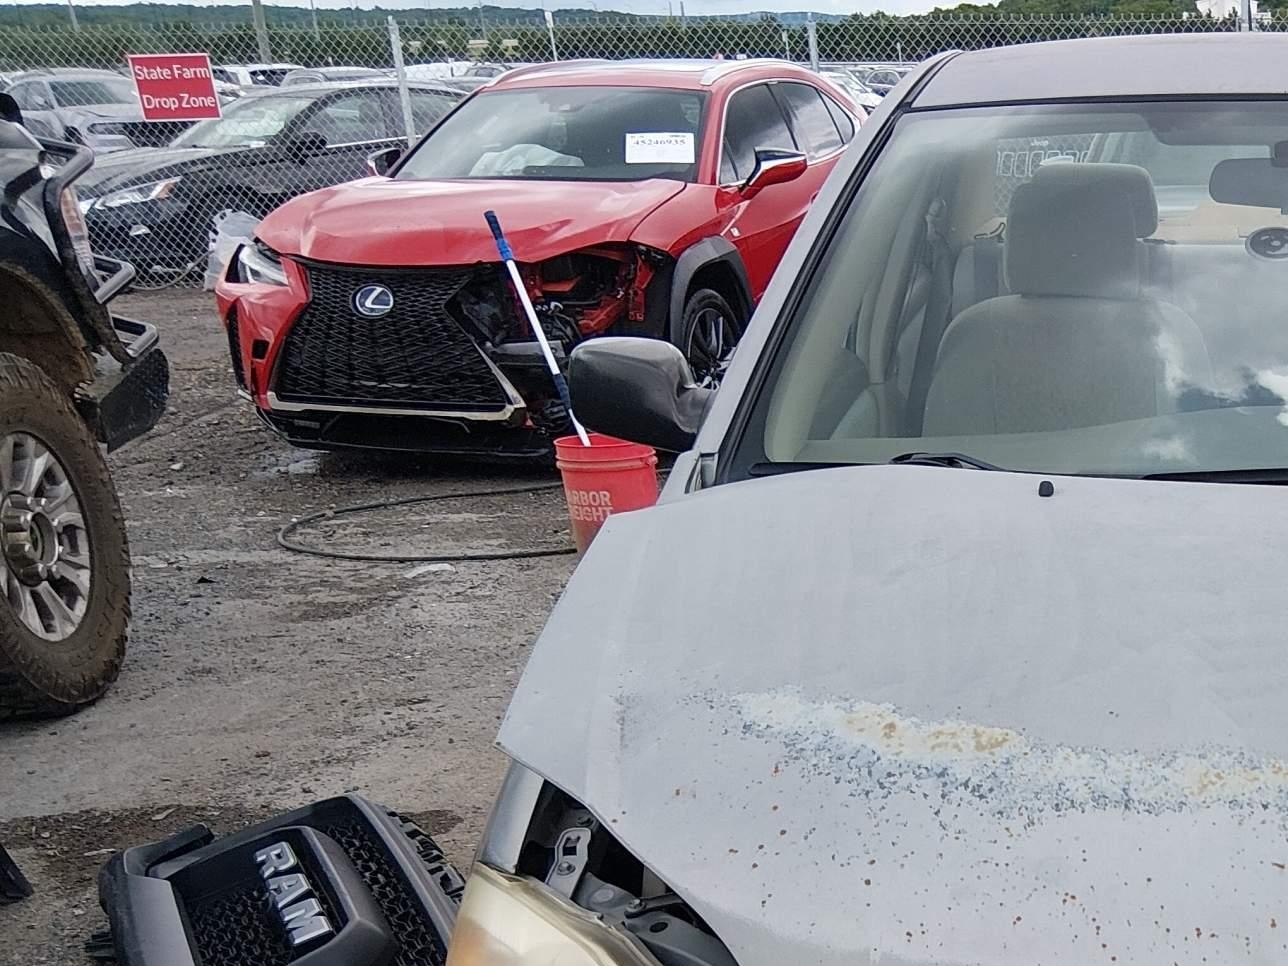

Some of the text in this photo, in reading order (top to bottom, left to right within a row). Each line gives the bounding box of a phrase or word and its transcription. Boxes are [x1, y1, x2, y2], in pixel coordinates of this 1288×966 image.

[134, 64, 211, 80] State Farm
[142, 93, 216, 112] Drop Zone
[255, 841, 333, 945] RAM
